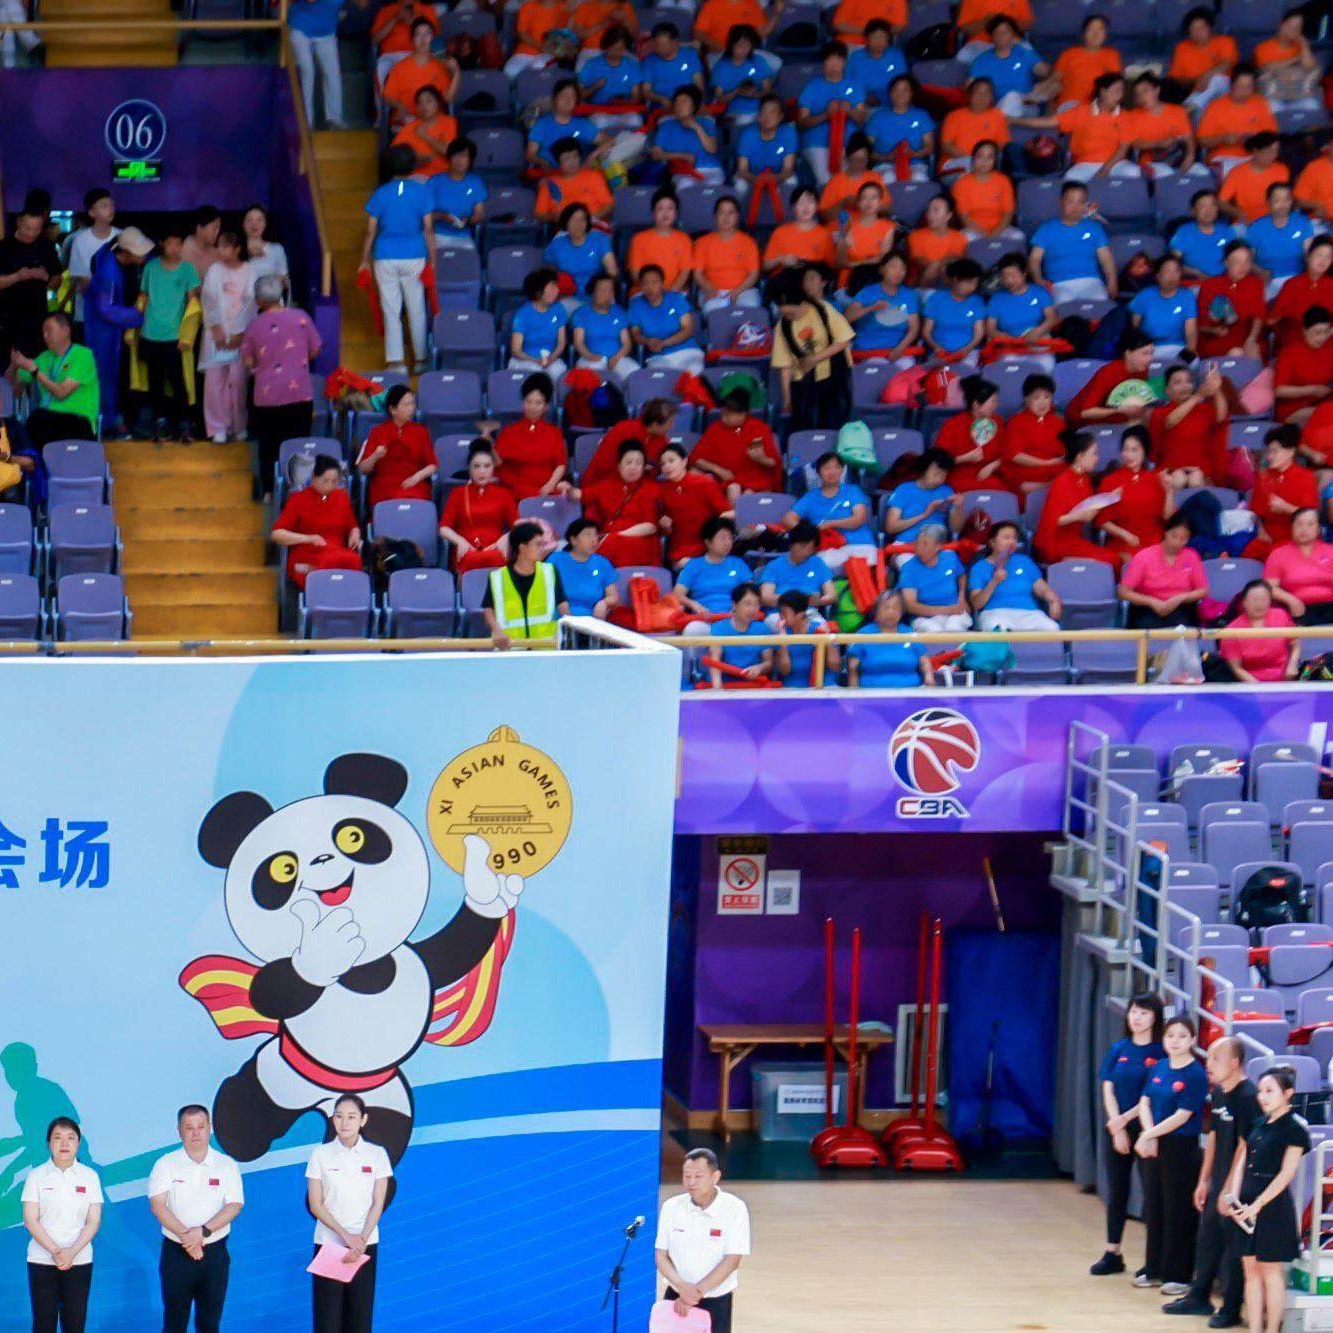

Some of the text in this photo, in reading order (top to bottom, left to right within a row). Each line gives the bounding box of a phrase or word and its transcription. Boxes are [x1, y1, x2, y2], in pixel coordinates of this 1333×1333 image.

[116, 113, 153, 149] 06
[452, 755, 505, 789] ASIAN
[518, 759, 560, 809] GAMES
[898, 798, 968, 817] CBA
